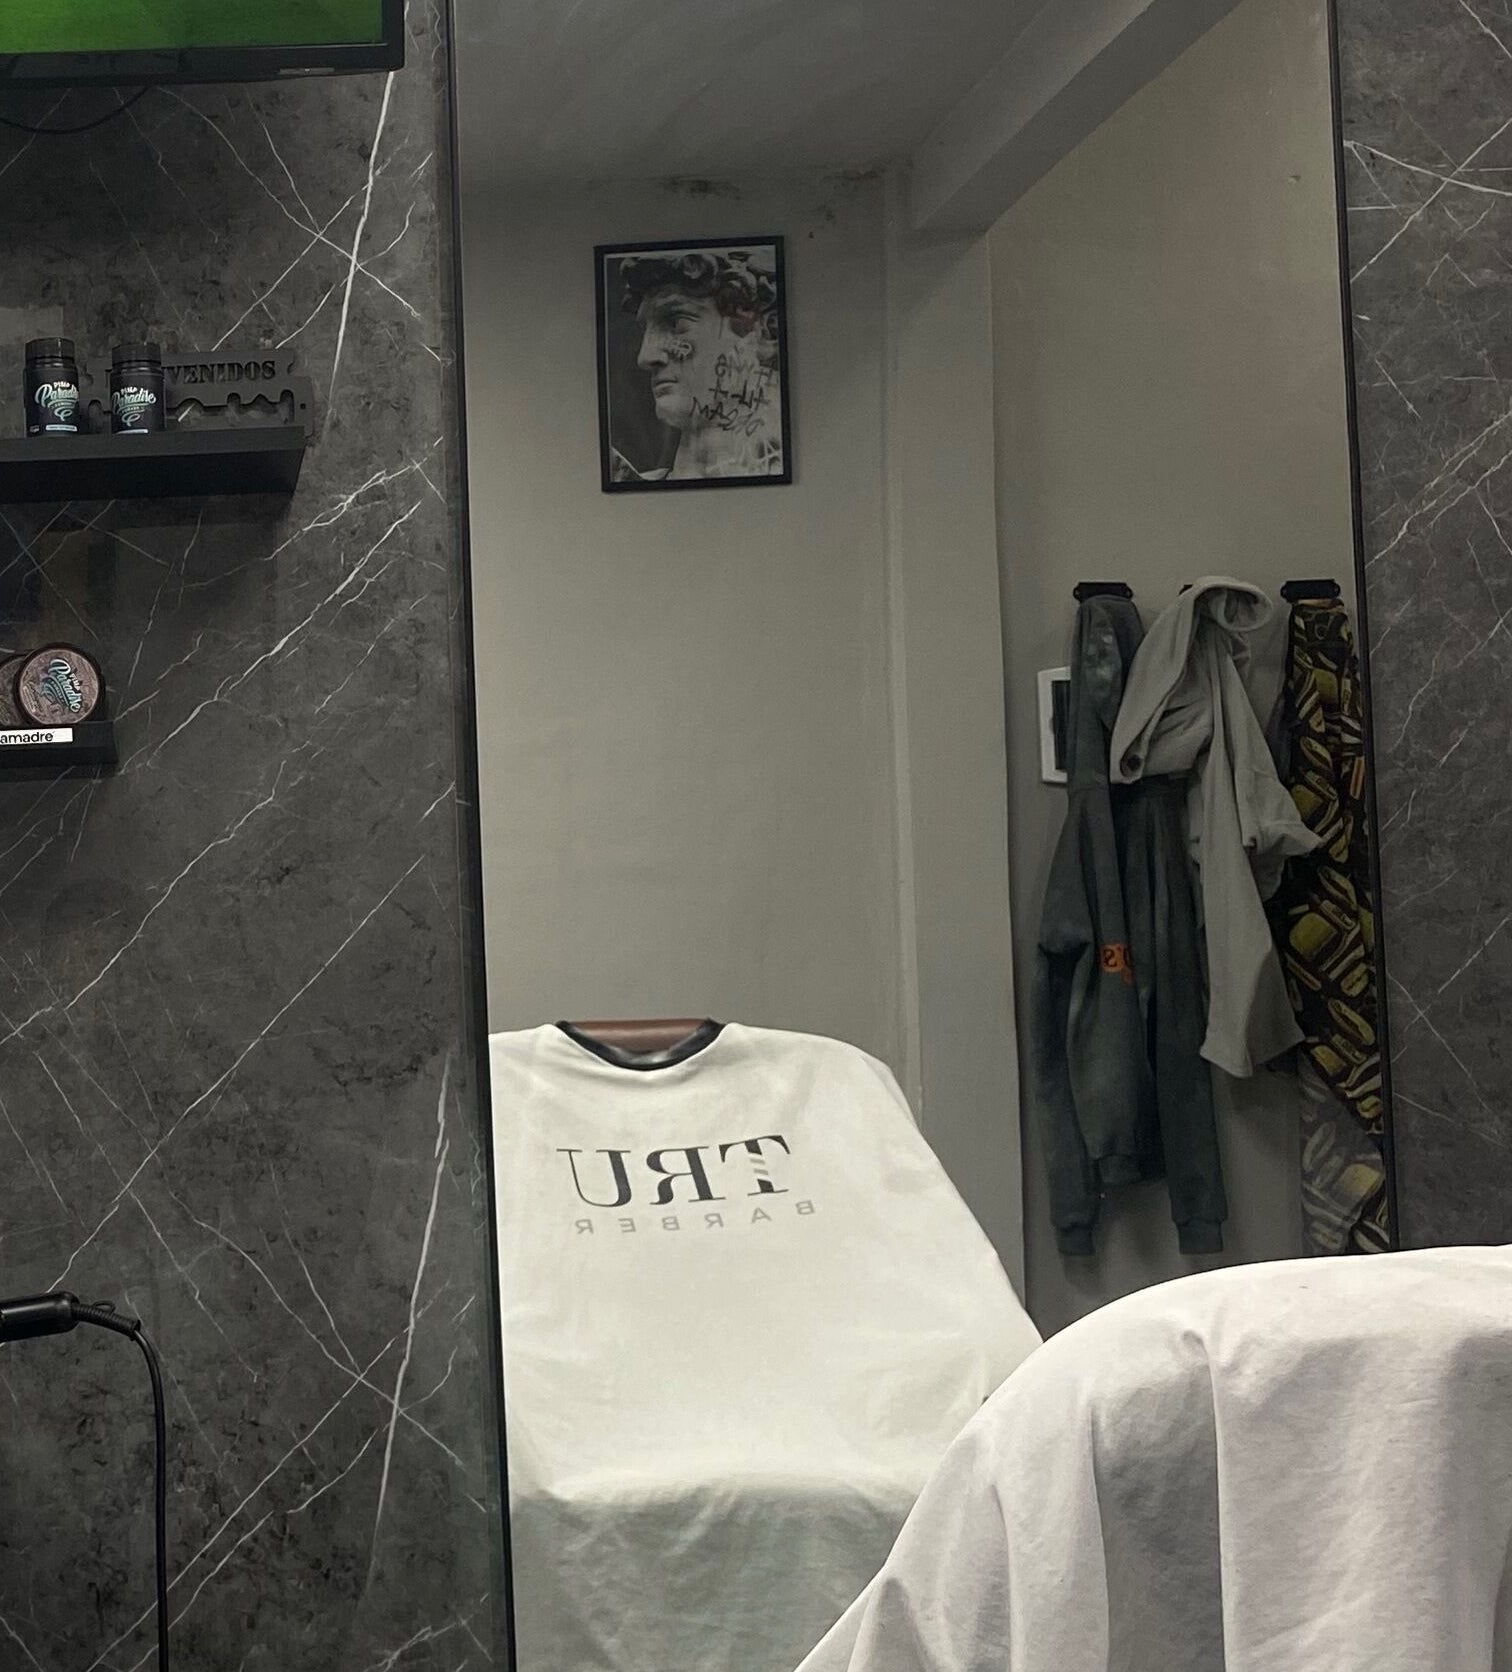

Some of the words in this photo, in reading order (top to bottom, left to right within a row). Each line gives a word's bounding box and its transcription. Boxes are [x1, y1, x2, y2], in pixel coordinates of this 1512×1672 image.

[105, 360, 276, 388] VENIDOS
[111, 388, 157, 415] Paradise
[48, 659, 83, 713] Paradise
